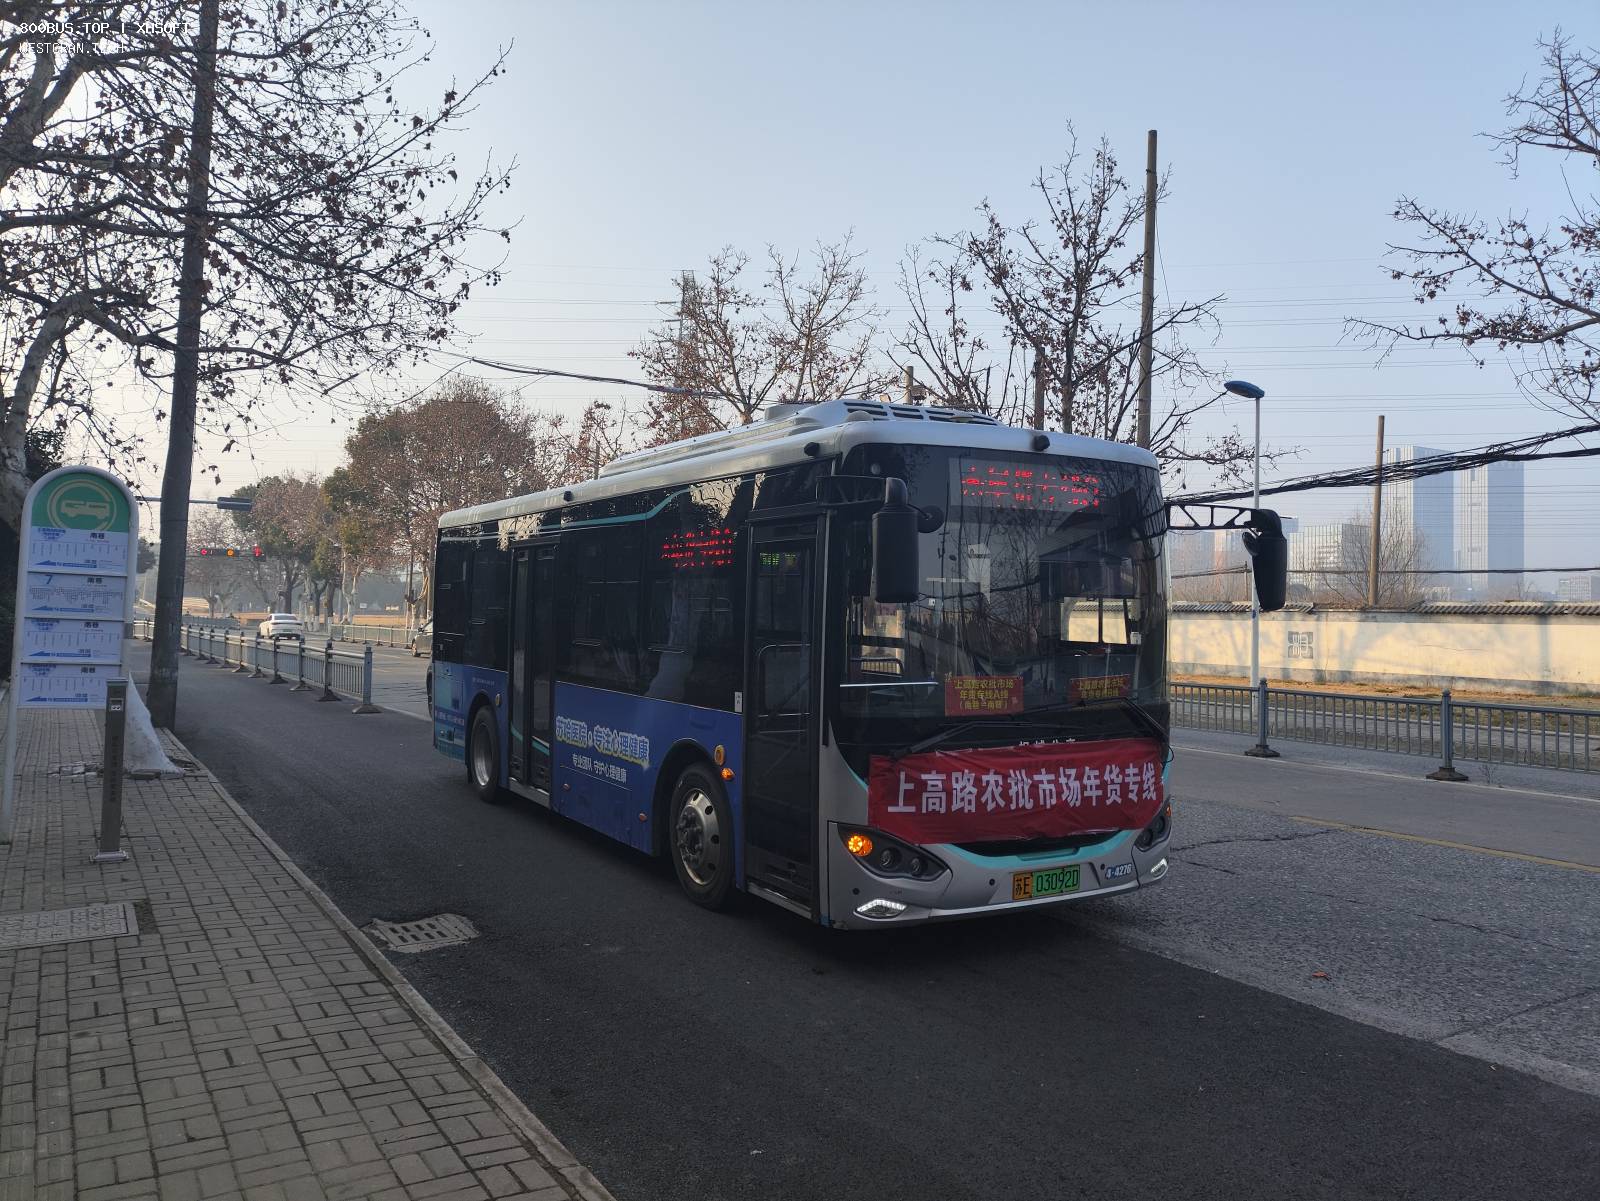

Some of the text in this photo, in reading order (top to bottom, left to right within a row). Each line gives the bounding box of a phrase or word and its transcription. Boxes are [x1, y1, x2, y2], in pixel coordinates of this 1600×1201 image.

[887, 762, 1158, 815] 上高路农批市场年货专线
